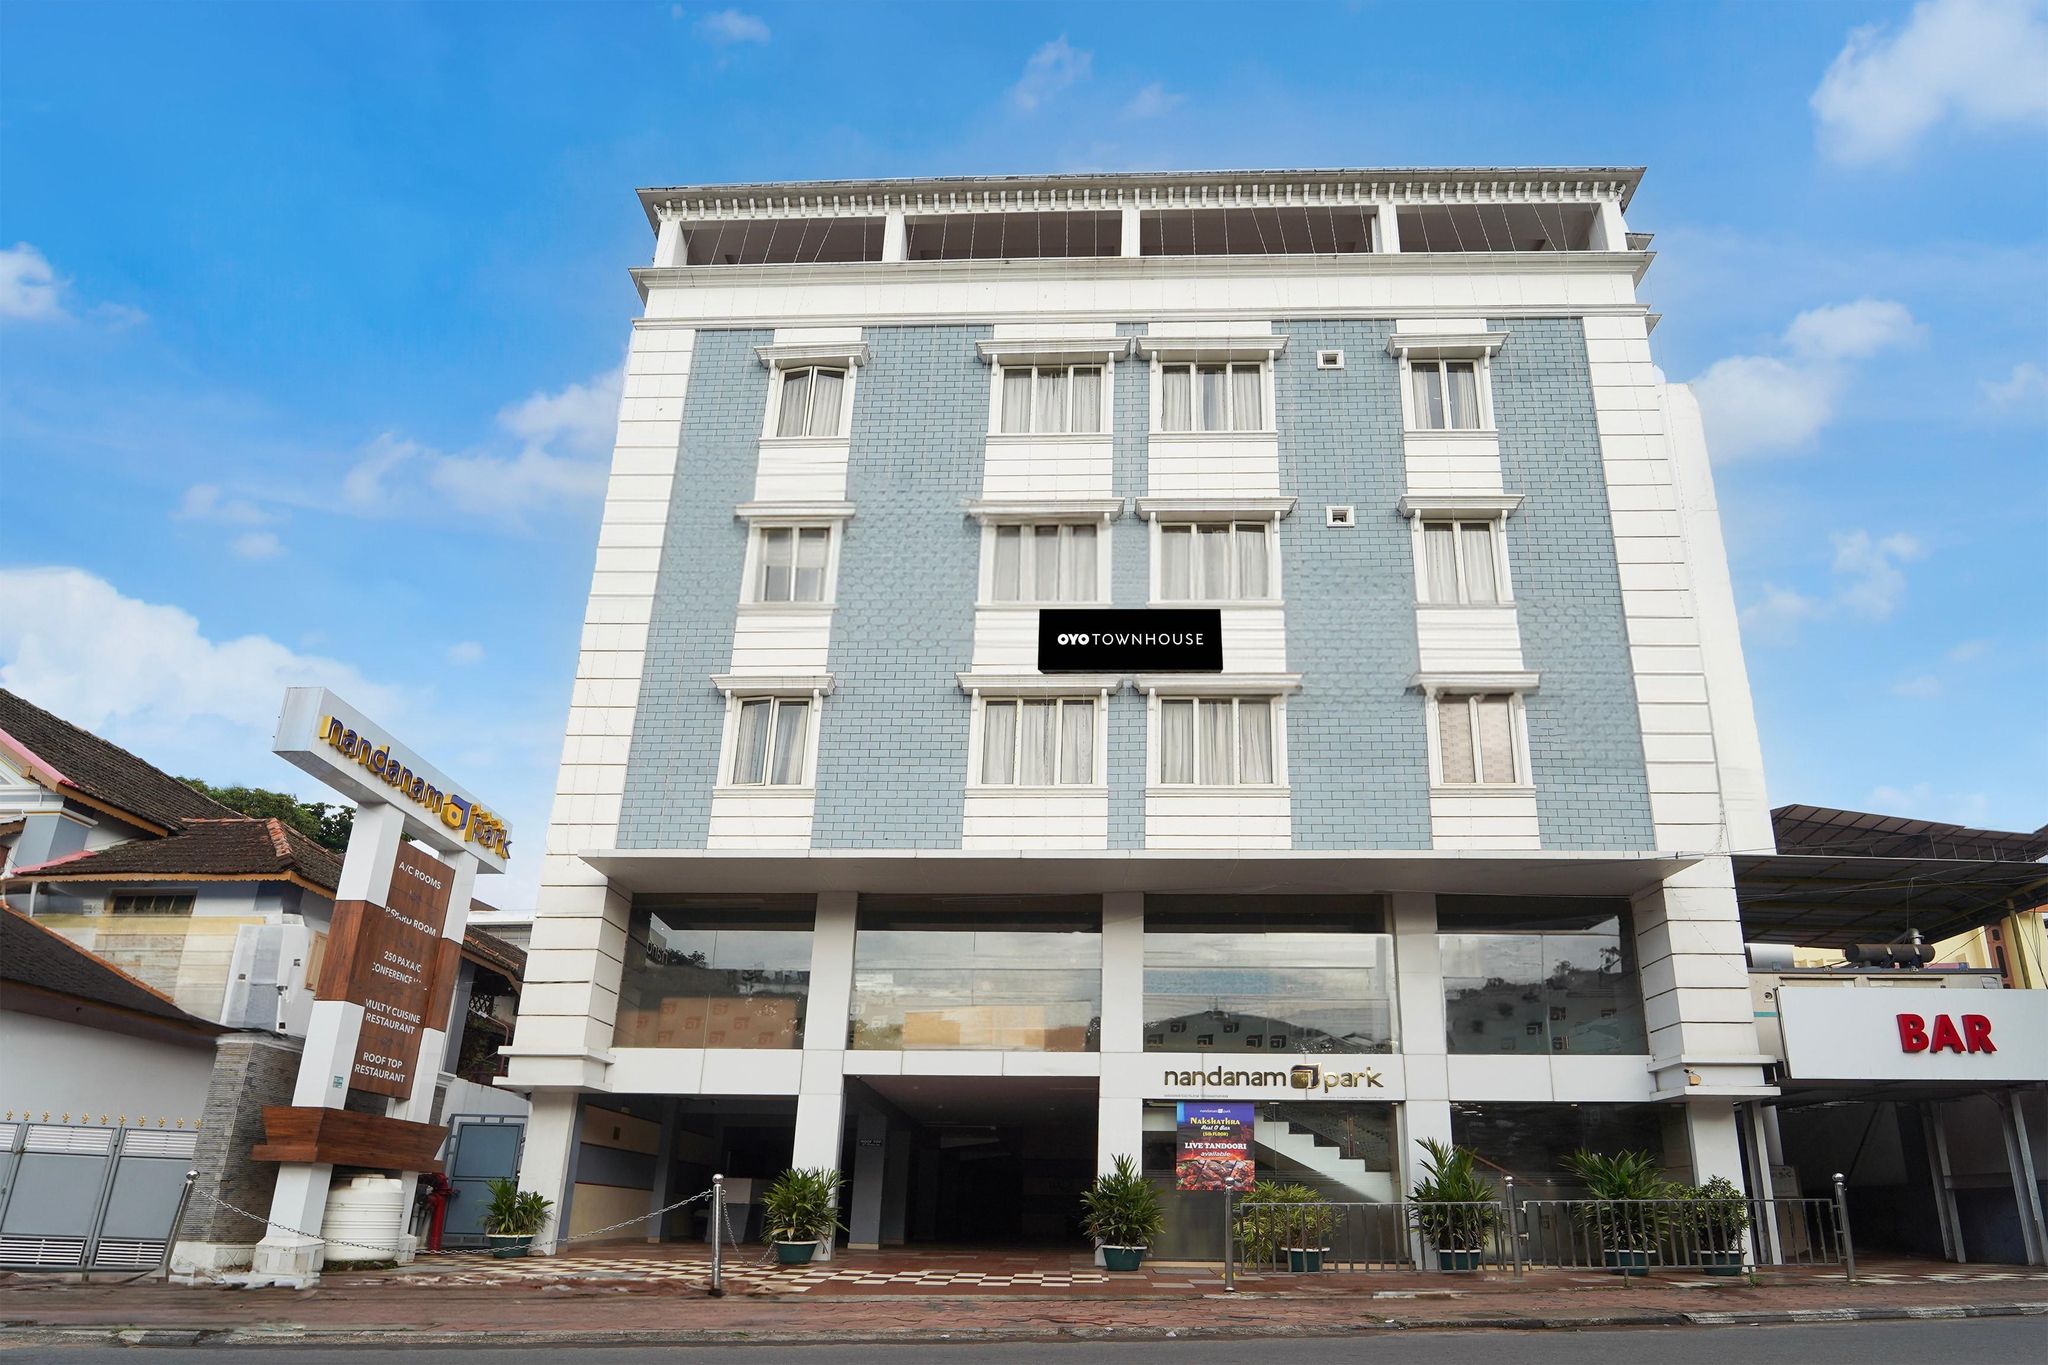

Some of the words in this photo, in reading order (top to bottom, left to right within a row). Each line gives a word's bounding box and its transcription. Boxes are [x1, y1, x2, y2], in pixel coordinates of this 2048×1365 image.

[1057, 633, 1090, 646] OYO
[1092, 633, 1204, 646] TOWNHOUSE
[319, 715, 444, 814] nandanam
[465, 803, 513, 860] park
[398, 861, 415, 876] A/C
[415, 869, 442, 890] ROOMS
[413, 919, 437, 937] ROOM
[384, 950, 397, 963] 250
[397, 956, 410, 968] PAX
[410, 962, 422, 973] A/C
[365, 998, 391, 1014] MULTY
[391, 1007, 421, 1024] CUISINE
[366, 1012, 416, 1035] RESTAURANT
[1896, 1014, 1998, 1054] BAR
[363, 1051, 387, 1065] ROOF
[387, 1057, 403, 1069] TOP
[354, 1063, 406, 1083] RESTAURANT
[1164, 1065, 1287, 1087] nandanam
[1324, 1066, 1384, 1093] park
[1204, 1142, 1247, 1150] TANDOORI
